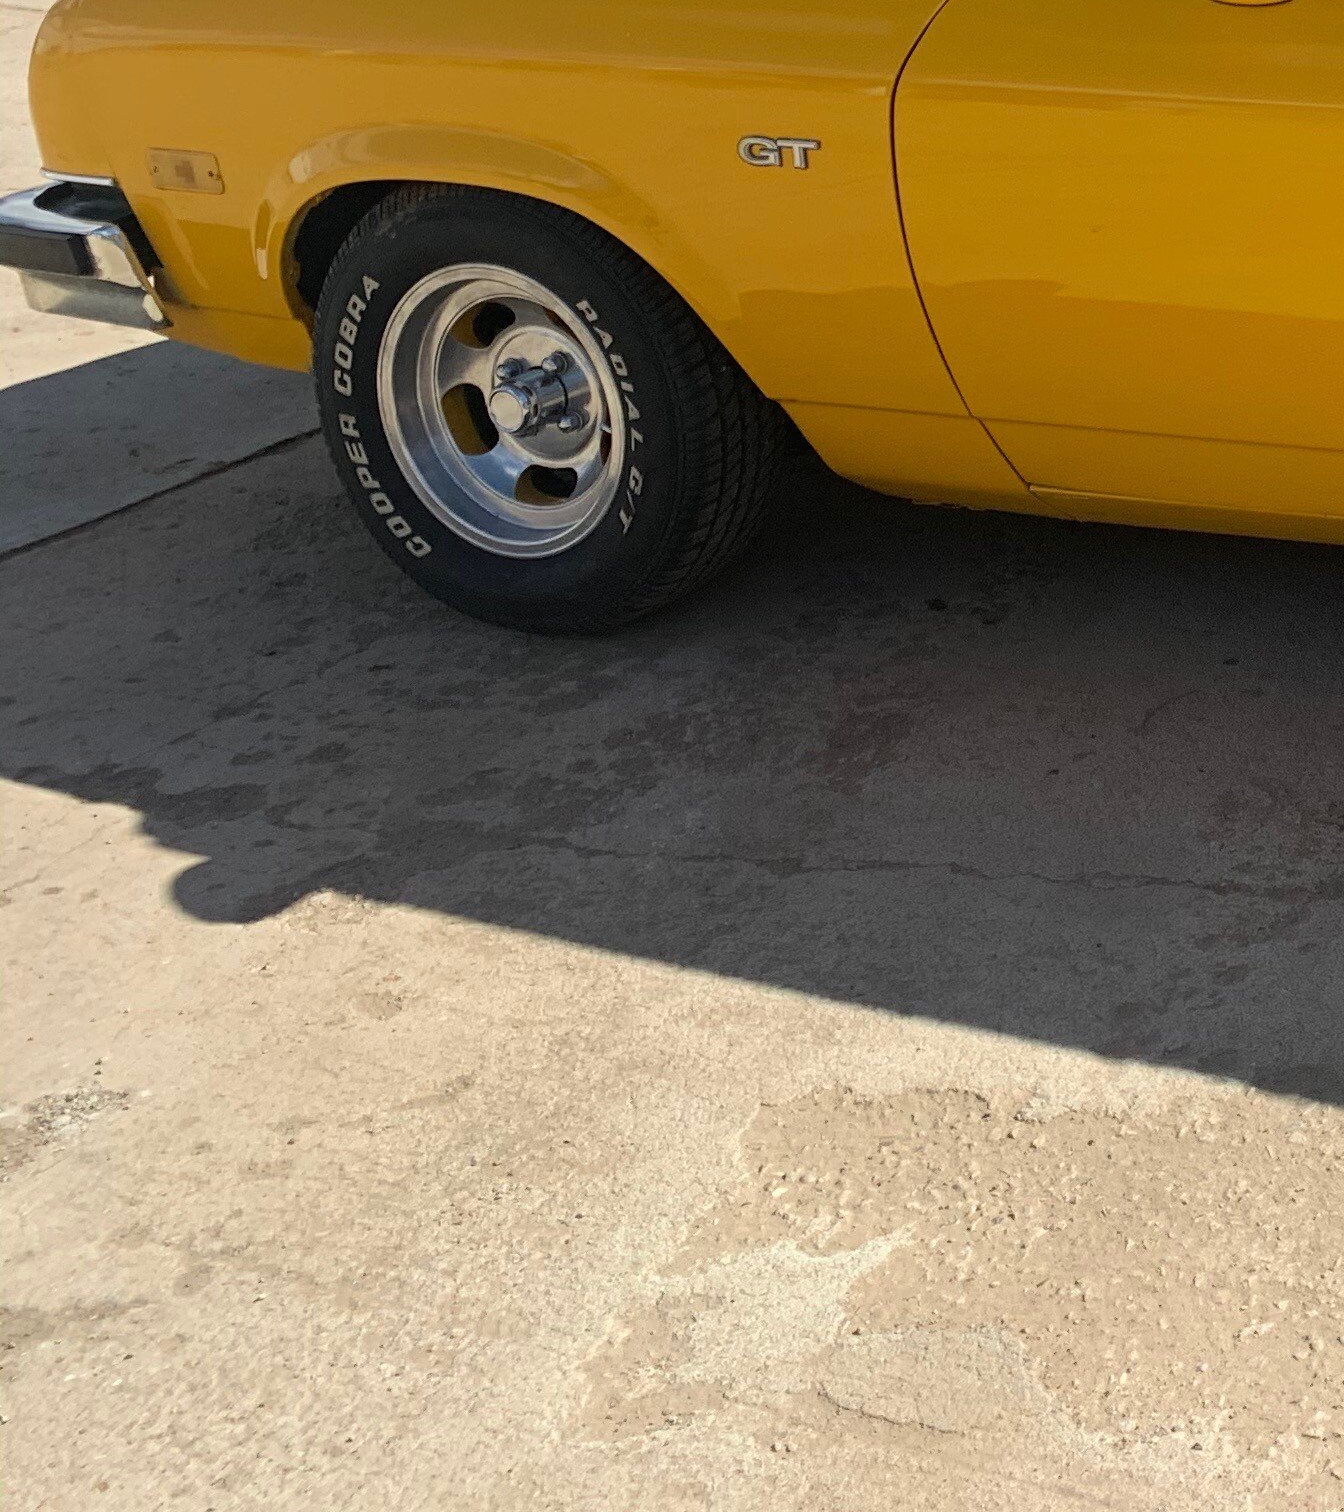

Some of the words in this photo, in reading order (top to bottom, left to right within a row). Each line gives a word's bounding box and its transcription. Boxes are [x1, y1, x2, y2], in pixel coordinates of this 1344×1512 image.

[737, 135, 821, 170] GT
[333, 275, 381, 397] COBRA
[576, 299, 644, 452] RADIAL
[618, 465, 644, 535] G/T
[338, 413, 432, 559] COOPER
